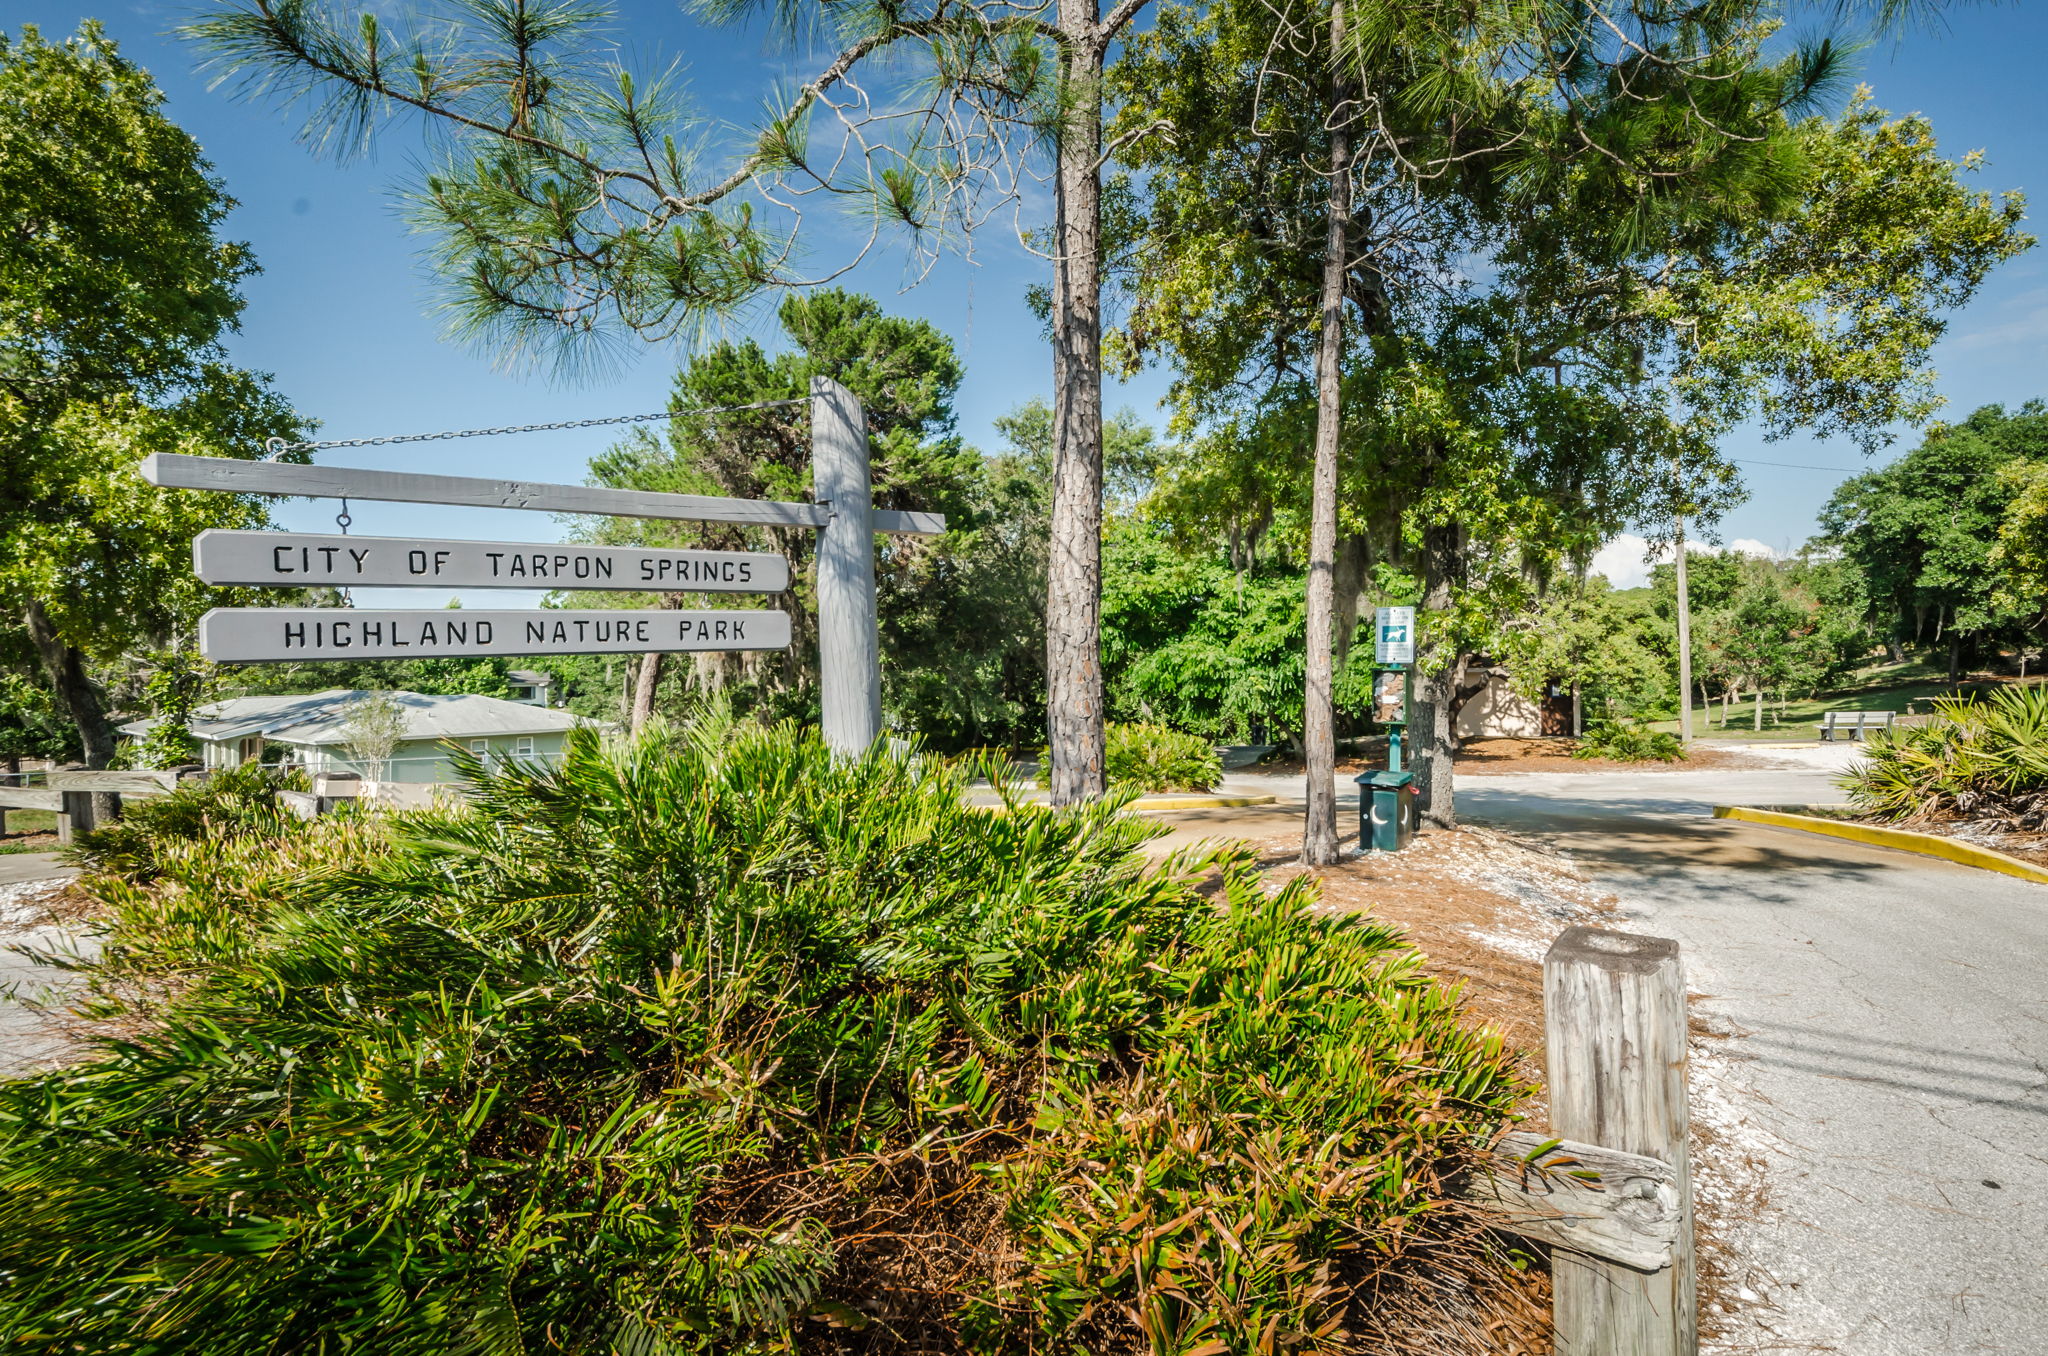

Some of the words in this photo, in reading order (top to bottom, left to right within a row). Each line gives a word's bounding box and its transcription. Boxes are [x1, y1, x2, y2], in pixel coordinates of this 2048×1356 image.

[273, 546, 370, 575] CITY
[408, 551, 451, 576] OF
[485, 553, 614, 580] TARPON
[640, 559, 752, 583] SPRINGS
[284, 621, 493, 649] HIGHLAND
[526, 620, 650, 644] NATURE
[679, 620, 745, 642] PARK
